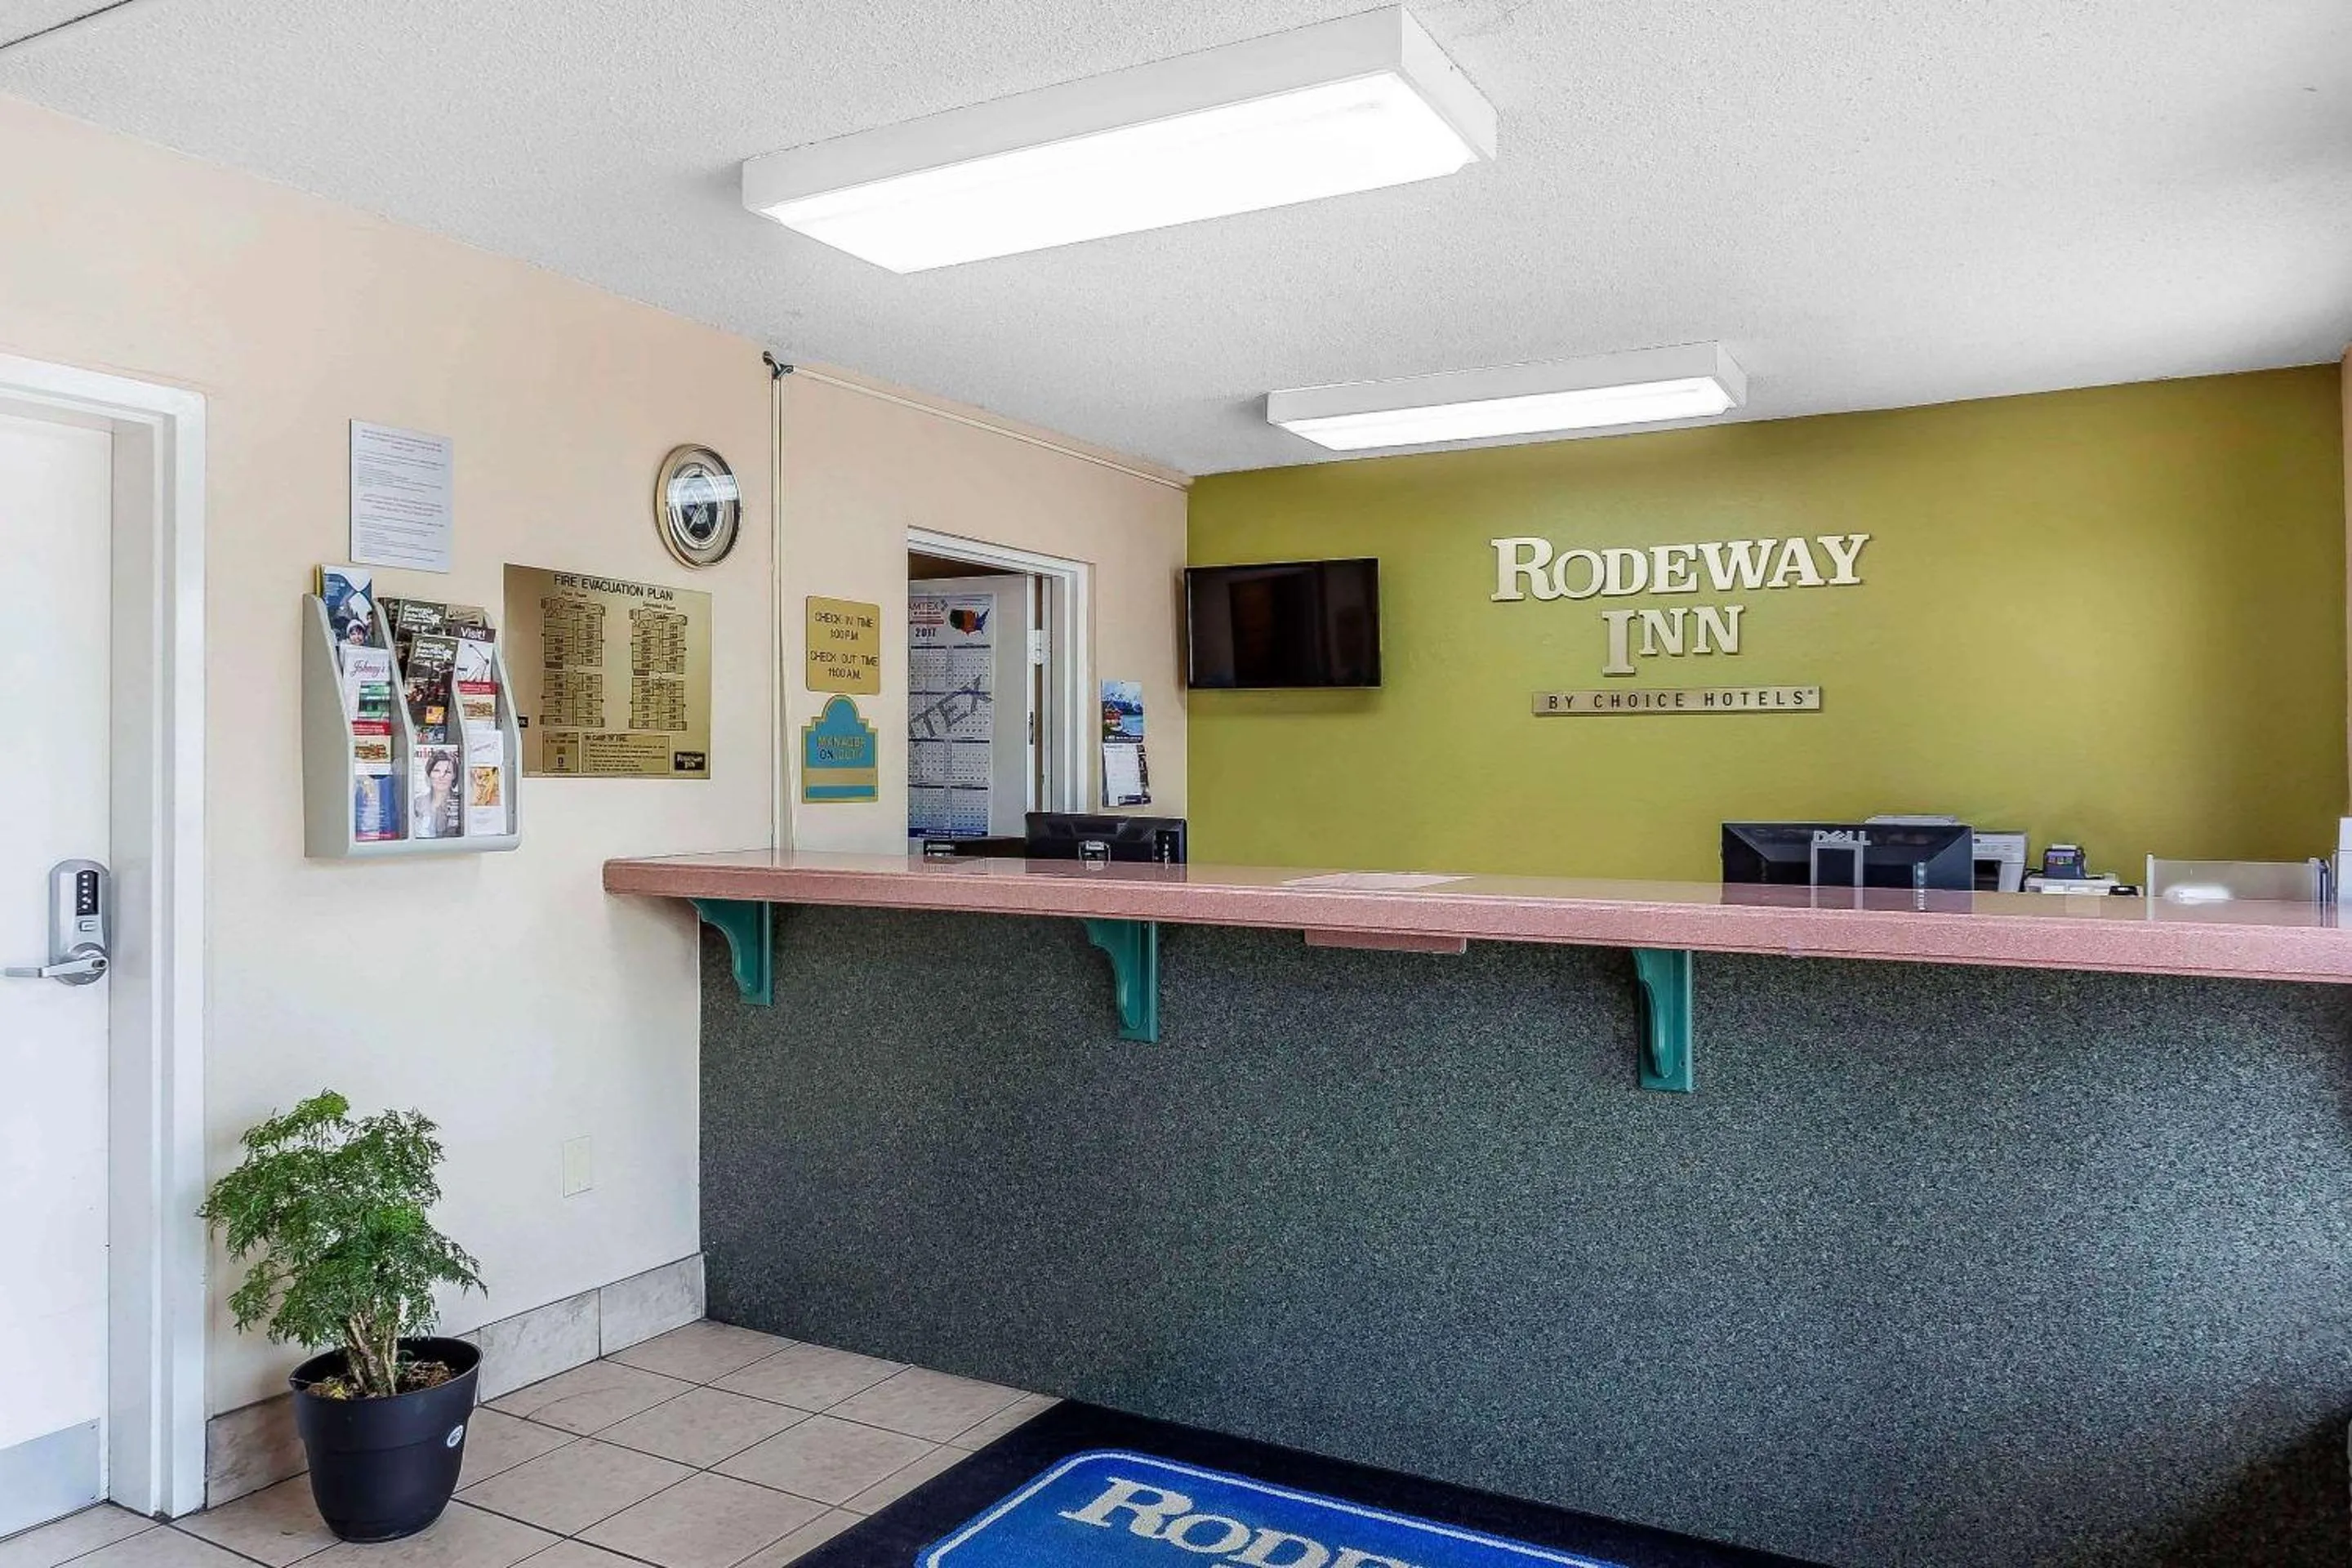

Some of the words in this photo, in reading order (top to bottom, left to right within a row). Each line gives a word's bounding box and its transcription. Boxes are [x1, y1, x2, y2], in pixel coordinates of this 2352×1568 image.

[1490, 534, 1871, 602] RODEWAY
[555, 574, 577, 588] FIRE
[581, 578, 644, 598] EVACUATION
[648, 587, 674, 601] PLAN
[815, 612, 841, 625] CHECK
[857, 617, 874, 628] TIME
[915, 626, 937, 638] 2017
[1601, 604, 1744, 676] INN
[810, 651, 836, 663] CHECK
[842, 653, 857, 664] OUT
[861, 655, 879, 666] TIME
[1548, 695, 1575, 710] BY
[1593, 693, 1686, 709] CHOICE
[1813, 830, 1872, 846] DELL
